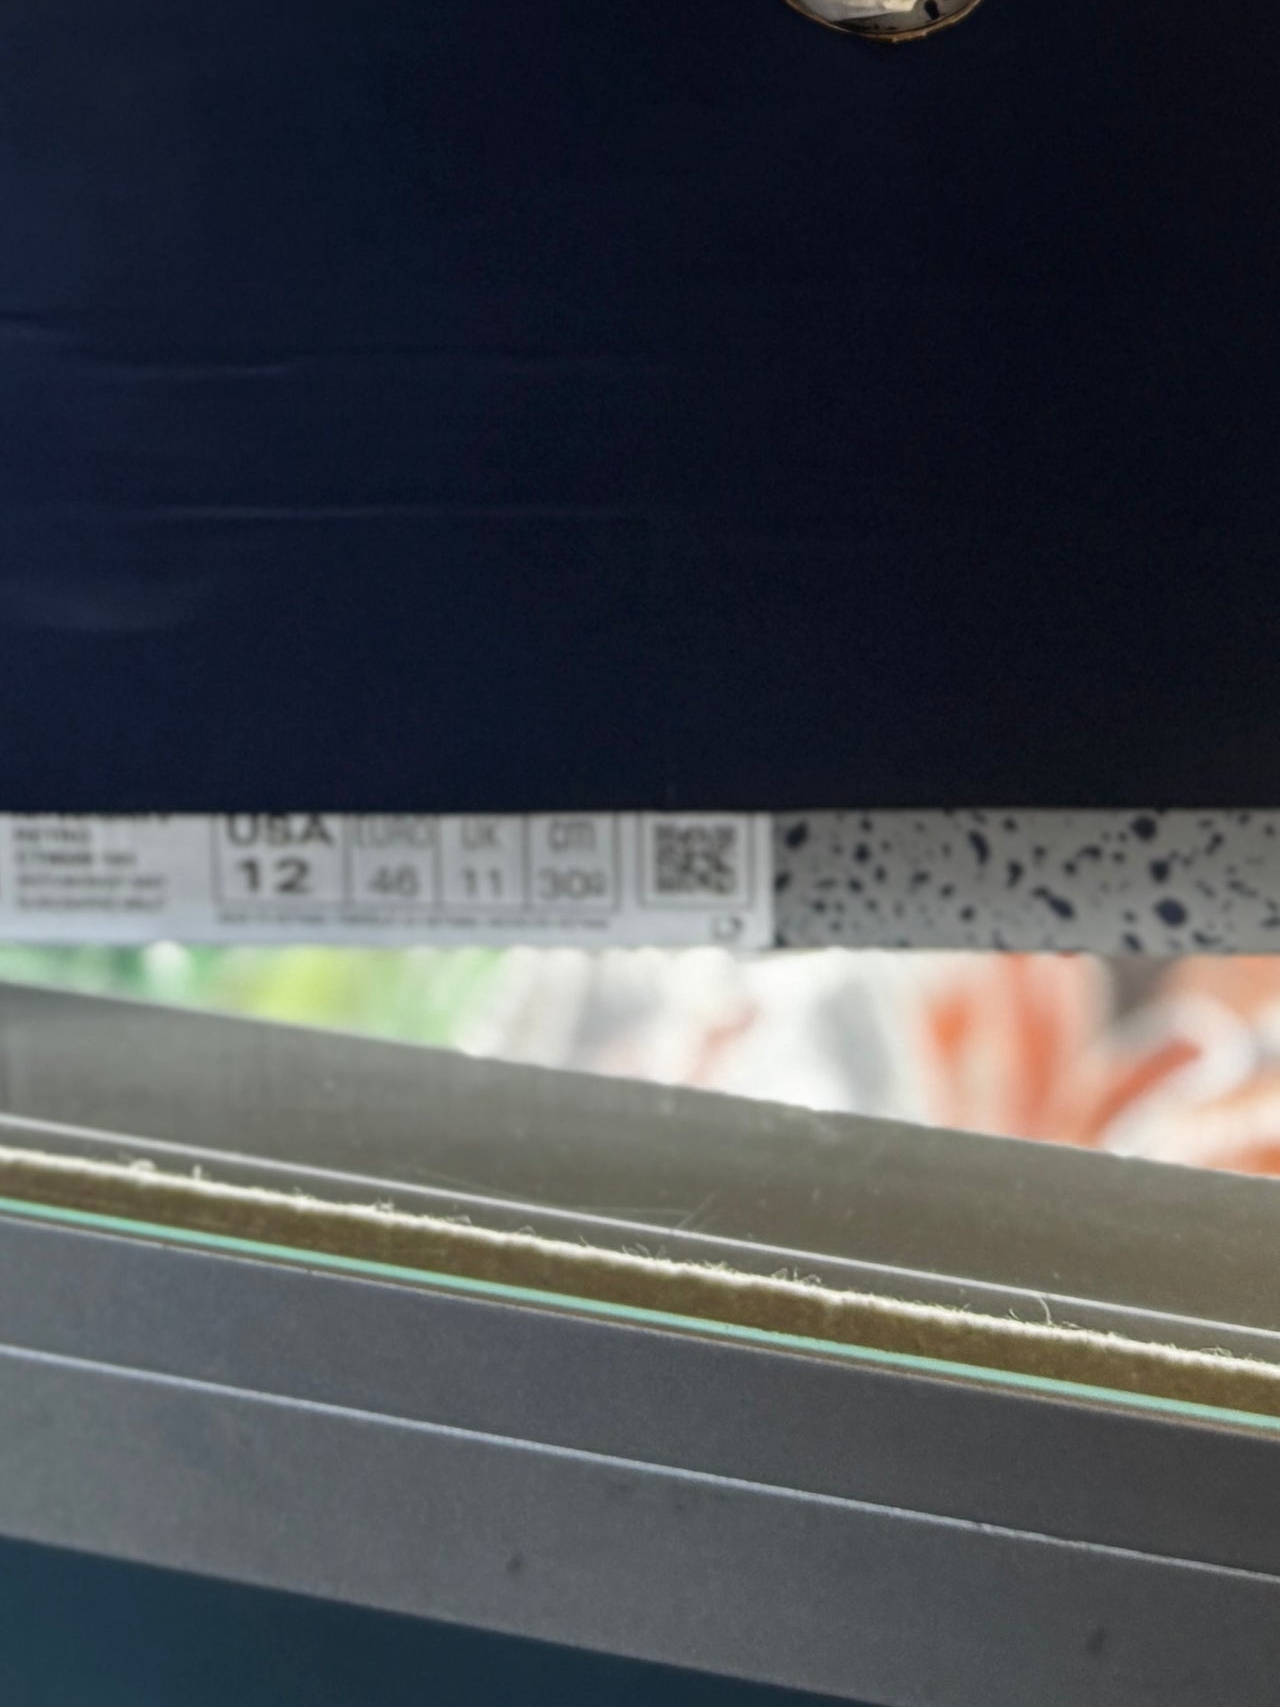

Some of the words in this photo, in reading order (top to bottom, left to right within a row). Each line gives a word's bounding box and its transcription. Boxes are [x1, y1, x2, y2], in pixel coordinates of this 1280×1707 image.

[225, 813, 334, 848] USA
[236, 856, 312, 895] 12
[461, 866, 503, 898] 11
